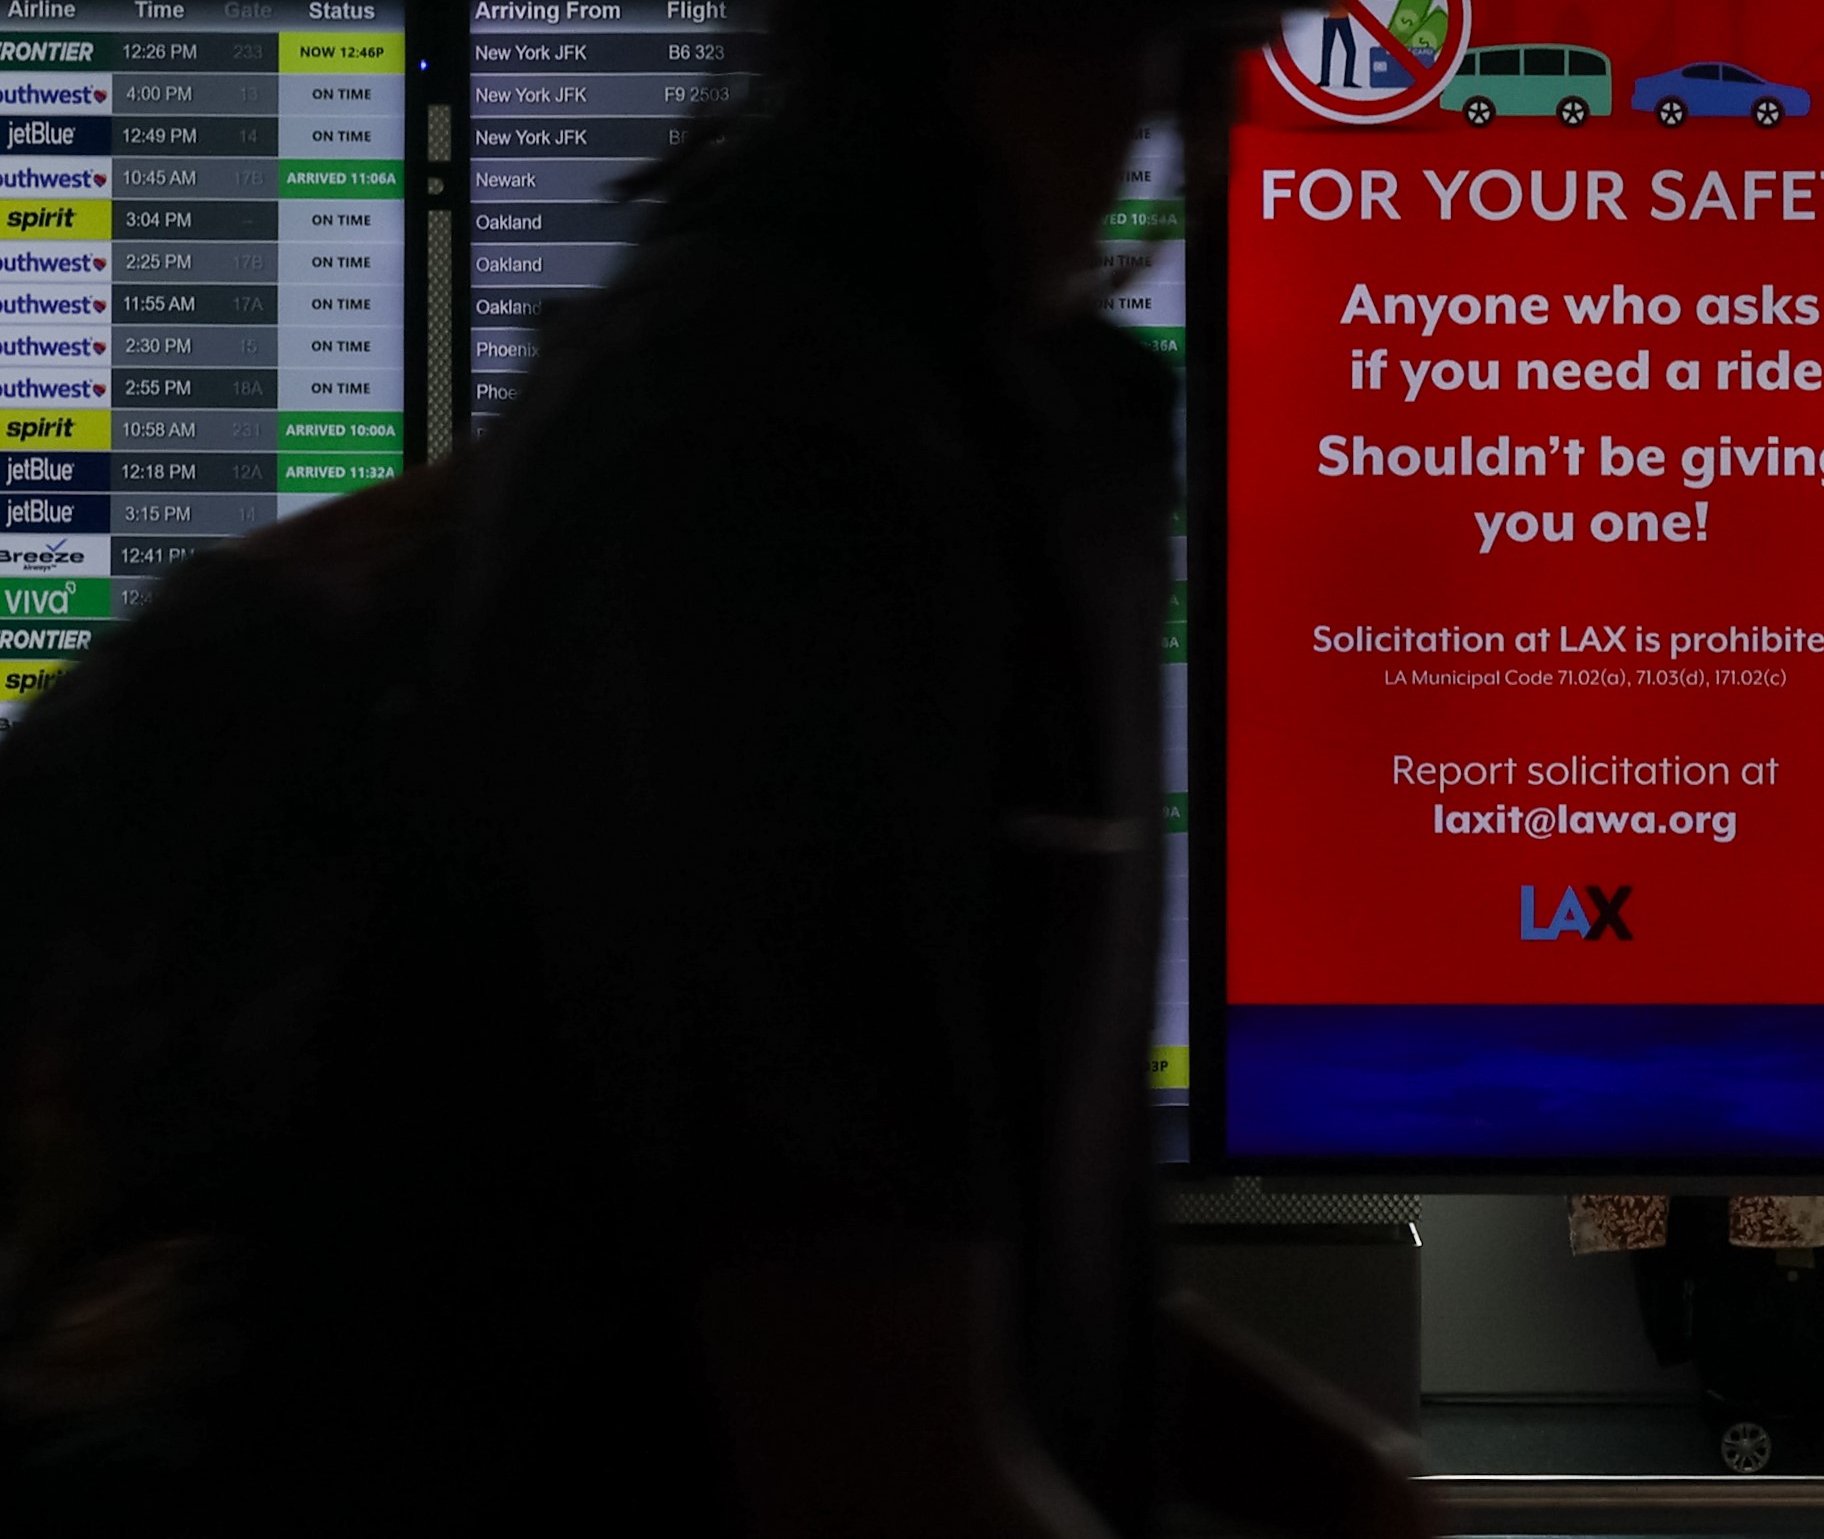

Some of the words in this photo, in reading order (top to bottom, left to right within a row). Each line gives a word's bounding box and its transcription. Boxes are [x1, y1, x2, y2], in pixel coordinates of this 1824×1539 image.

[135, 1, 184, 18] Time
[225, 1, 272, 20] Gate
[309, 1, 375, 20] Status
[476, 1, 561, 23] Arriving
[567, 2, 621, 18] From
[668, 1, 724, 23] Flight
[7, 121, 75, 149] jetBlue
[123, 128, 165, 143] 12:49
[171, 128, 196, 143] PM
[1263, 169, 1401, 220] FOR
[1423, 170, 1627, 221] YOUR
[1340, 284, 1548, 336] Anyone
[1564, 284, 1681, 324] who
[1697, 285, 1819, 325] asks
[1352, 349, 1387, 389] if
[1400, 360, 1499, 402] you
[1518, 350, 1649, 390] need
[1666, 361, 1699, 390] a
[1718, 350, 1822, 390] ride
[1601, 436, 1665, 476] be
[1474, 511, 1573, 553] you
[1591, 502, 1708, 542] one!
[1314, 626, 1504, 652] Solicitation
[1515, 628, 1550, 652] at
[1560, 626, 1628, 653] LAX
[1637, 626, 1660, 652] is
[1386, 670, 1407, 685] LA
[1412, 670, 1499, 689] Municipal
[1505, 670, 1553, 685] Code
[1558, 669, 1630, 686] 71.02(a),
[1637, 669, 1709, 687] 71.03(d),
[1716, 669, 1786, 686] 171.02(c)
[1394, 756, 1517, 793] Report
[1528, 756, 1728, 785] solicitation
[1742, 758, 1778, 785] at
[1435, 804, 1736, 842] laxit@lawa.org
[1521, 885, 1633, 941] LAX
